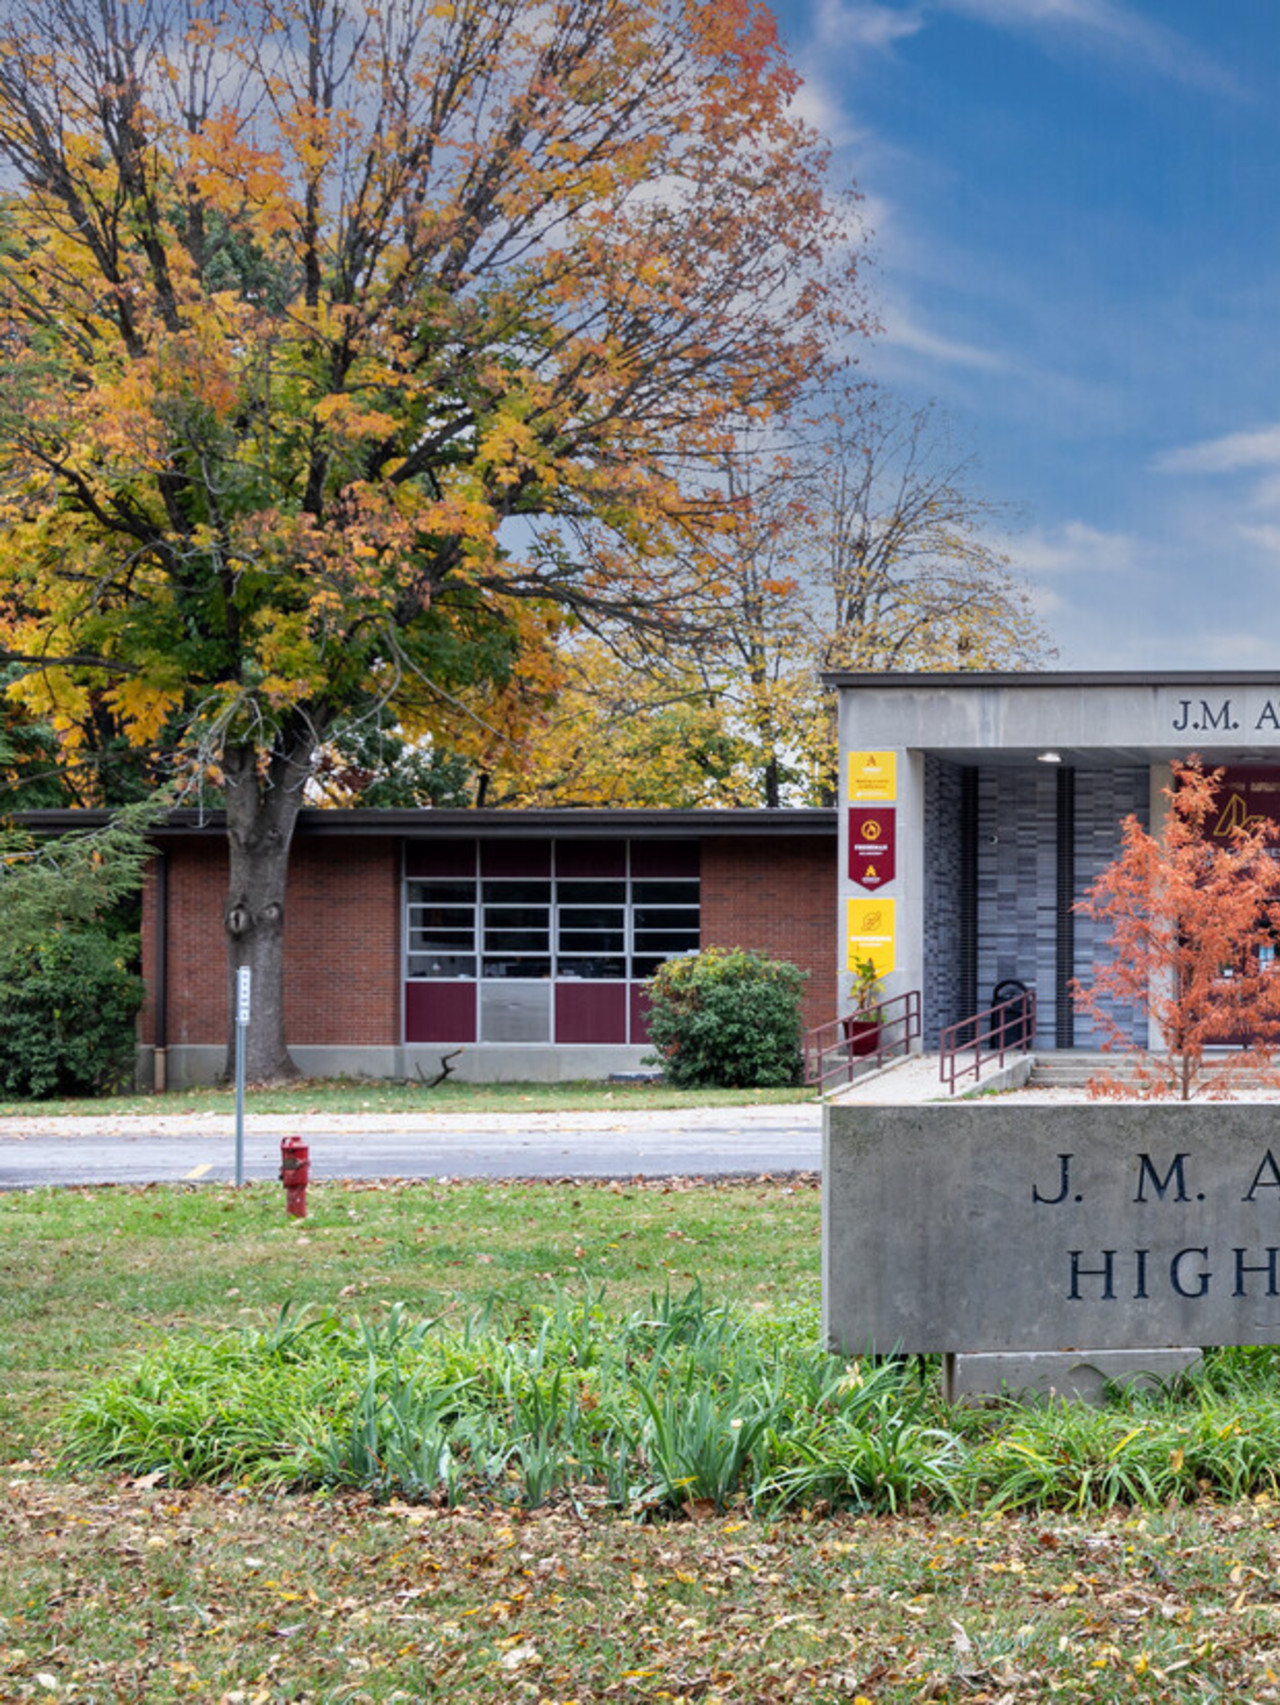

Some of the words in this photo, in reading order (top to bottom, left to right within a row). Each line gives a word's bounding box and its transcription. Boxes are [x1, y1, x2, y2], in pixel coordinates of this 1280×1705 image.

[1172, 699, 1240, 731] J.M.
[1031, 1153, 1084, 1205] J.
[1132, 1152, 1206, 1204] M.
[1066, 1246, 1280, 1301] HIGH
